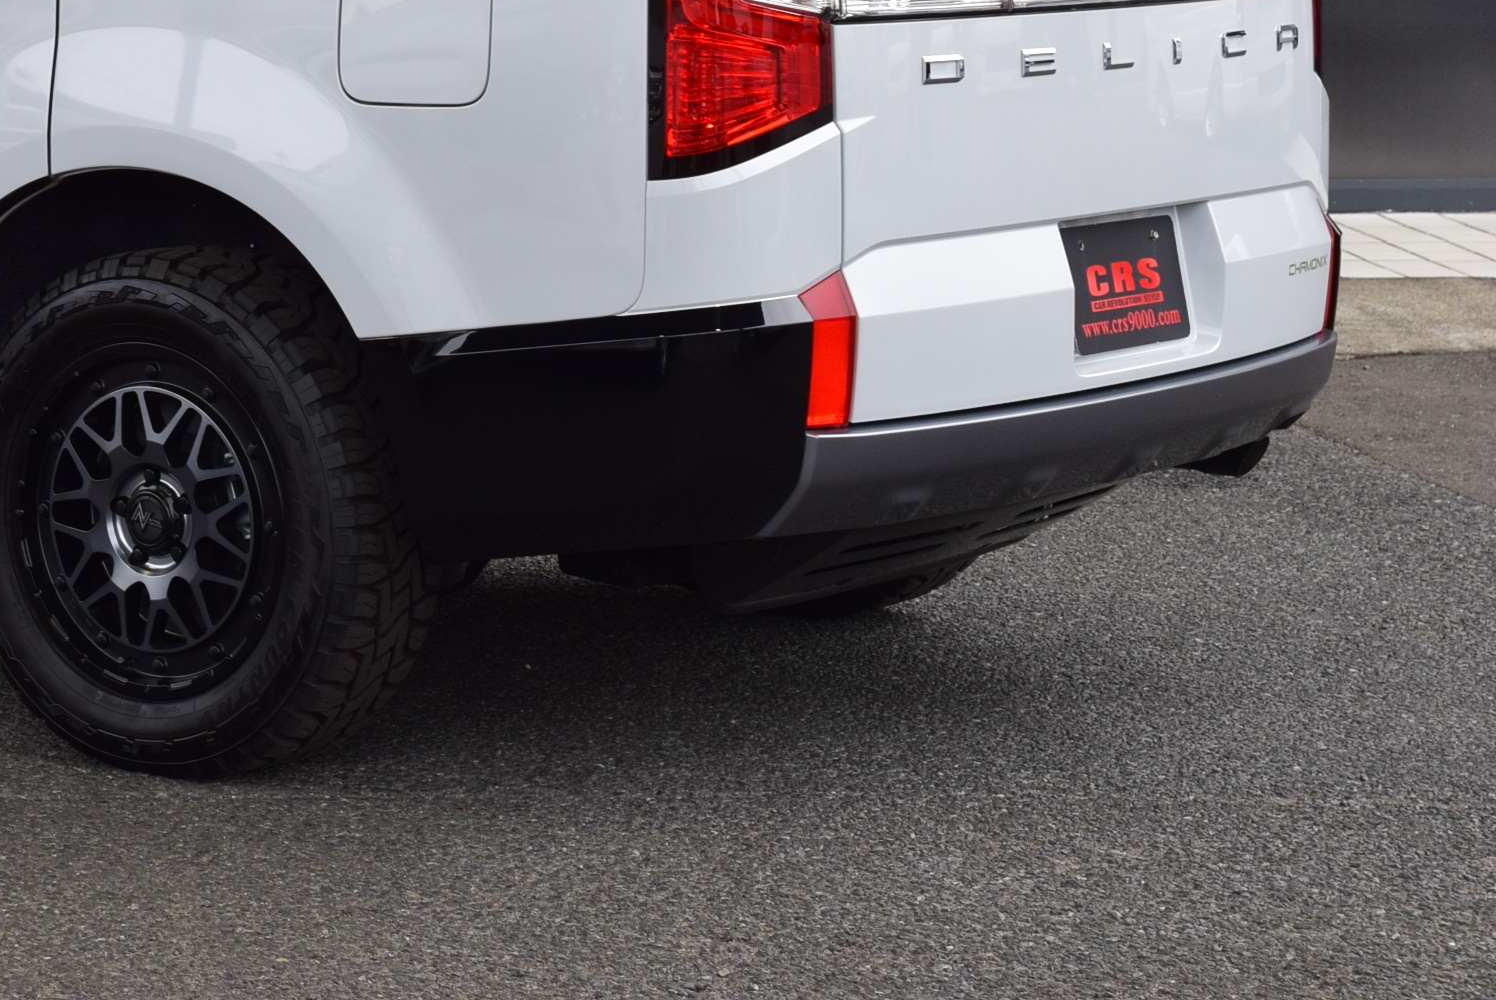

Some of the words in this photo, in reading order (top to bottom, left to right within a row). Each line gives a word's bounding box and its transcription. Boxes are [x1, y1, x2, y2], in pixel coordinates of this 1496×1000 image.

[921, 23, 1299, 85] DELICA
[1086, 257, 1162, 297] CRS
[1093, 301, 1107, 311] CAR
[1107, 295, 1143, 309] REVOLUTION
[1144, 291, 1162, 303] STYLE
[1081, 308, 1182, 338] www.crs9000.com
